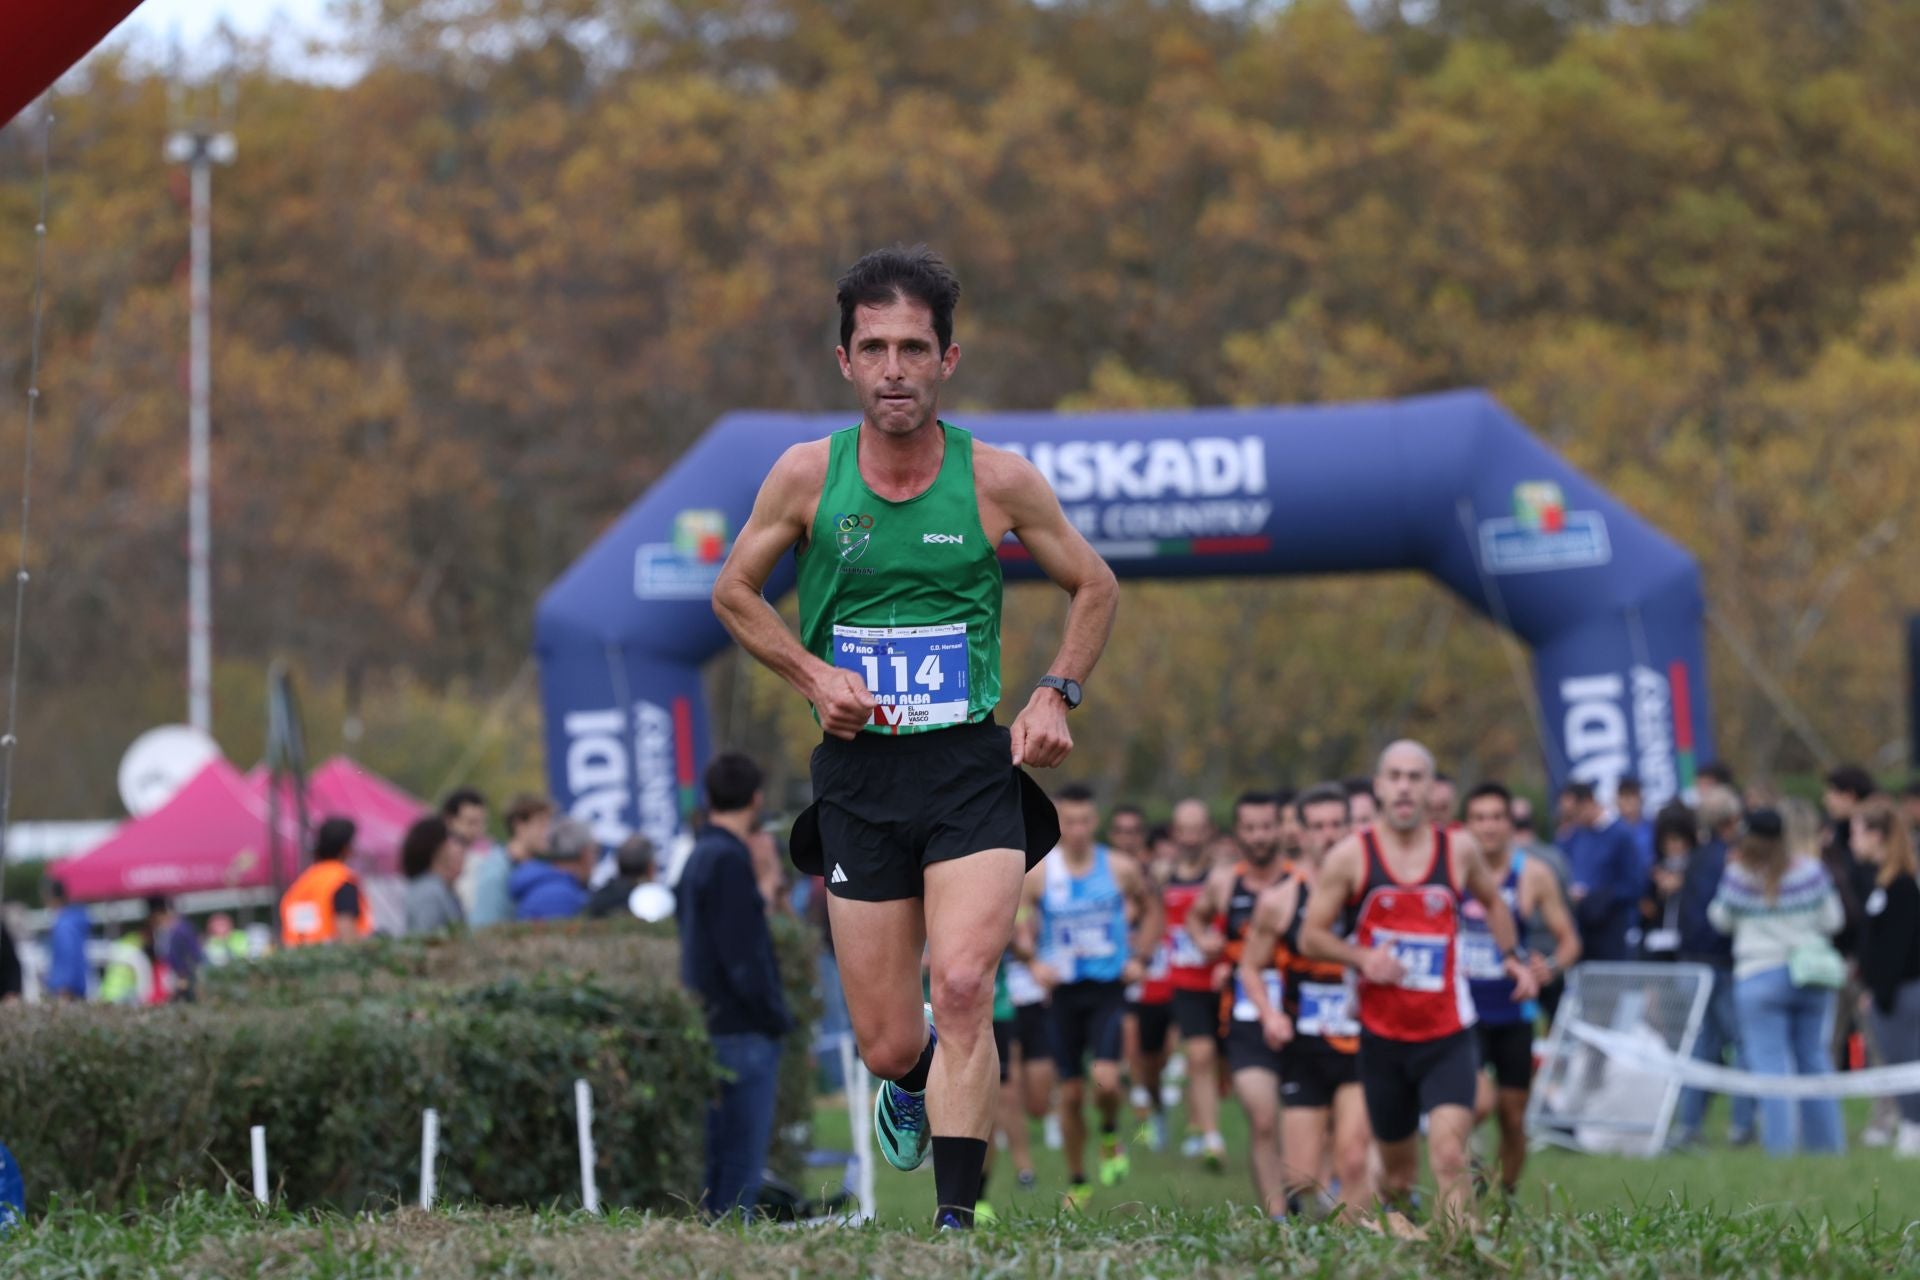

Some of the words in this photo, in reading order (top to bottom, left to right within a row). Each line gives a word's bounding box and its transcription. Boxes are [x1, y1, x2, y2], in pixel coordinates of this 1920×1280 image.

[841, 642, 855, 653] 69
[862, 655, 944, 692] 114
[872, 694, 896, 705] BAI
[899, 693, 931, 705] ALBA
